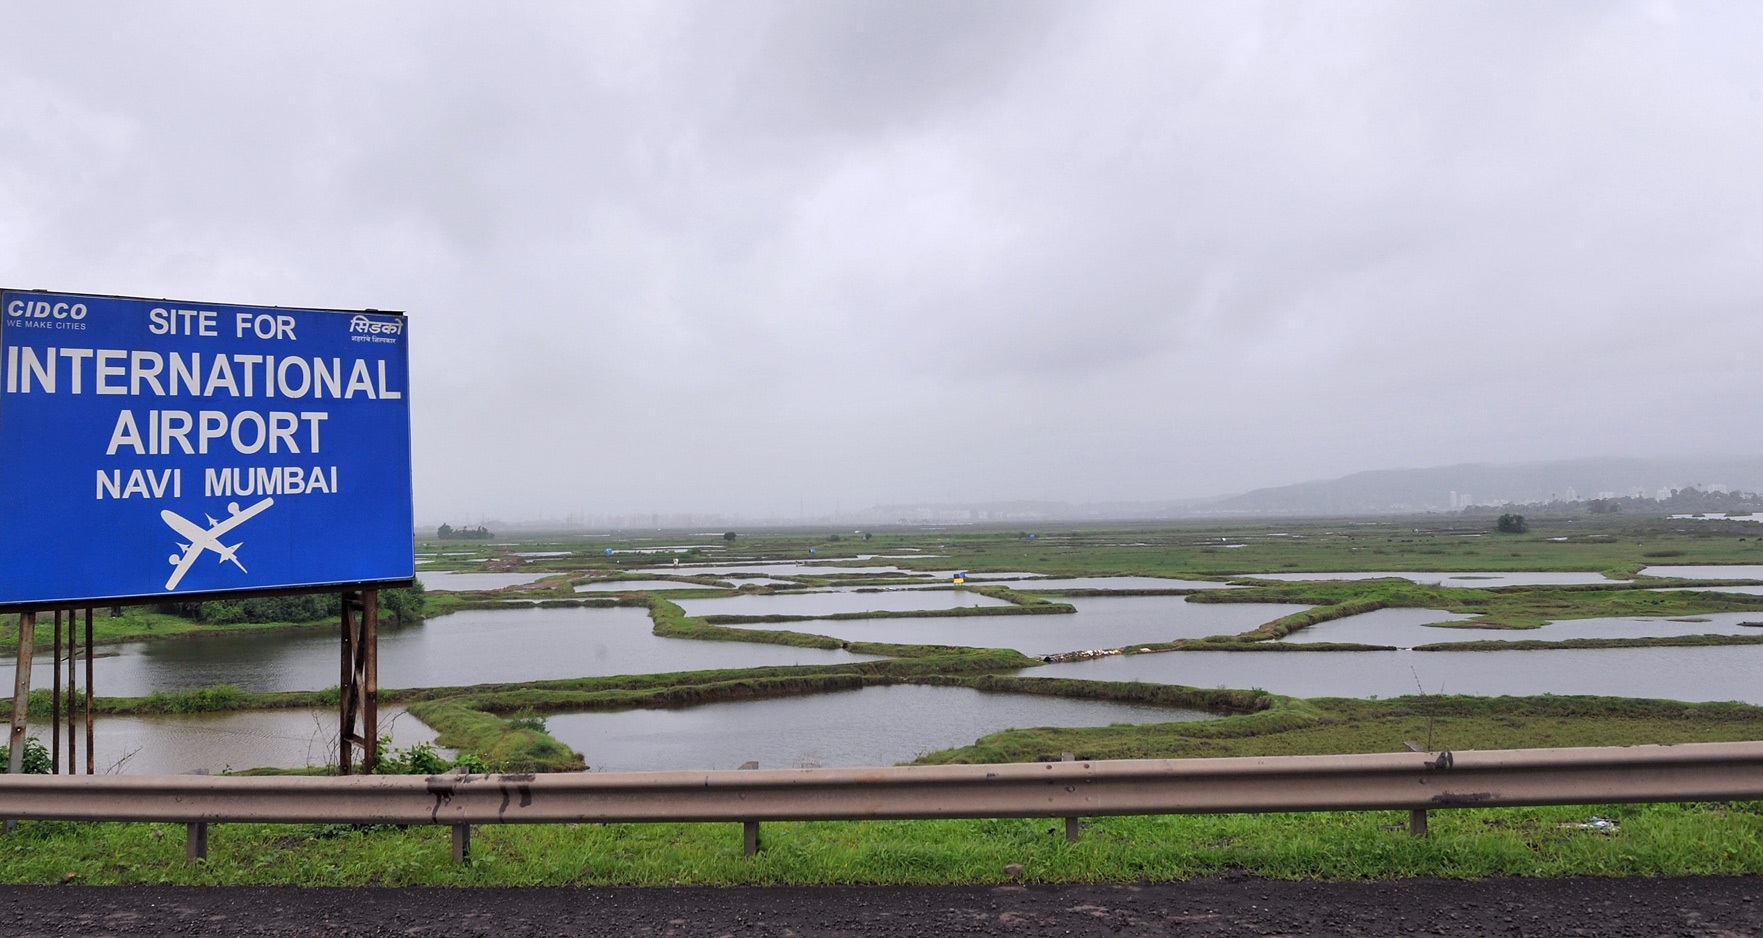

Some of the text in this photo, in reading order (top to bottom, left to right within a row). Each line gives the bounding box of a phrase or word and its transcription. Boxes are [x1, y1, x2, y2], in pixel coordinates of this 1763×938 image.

[8, 300, 87, 320] CIDCO
[25, 320, 53, 329] MAKE
[56, 322, 87, 330] CITIES
[149, 308, 297, 341] SITE FOR
[349, 314, 403, 335] सिडको
[7, 346, 401, 399] INTERNATIONAL
[106, 410, 328, 455] AIRPORT
[97, 466, 337, 499] NAVI MUMBAI
